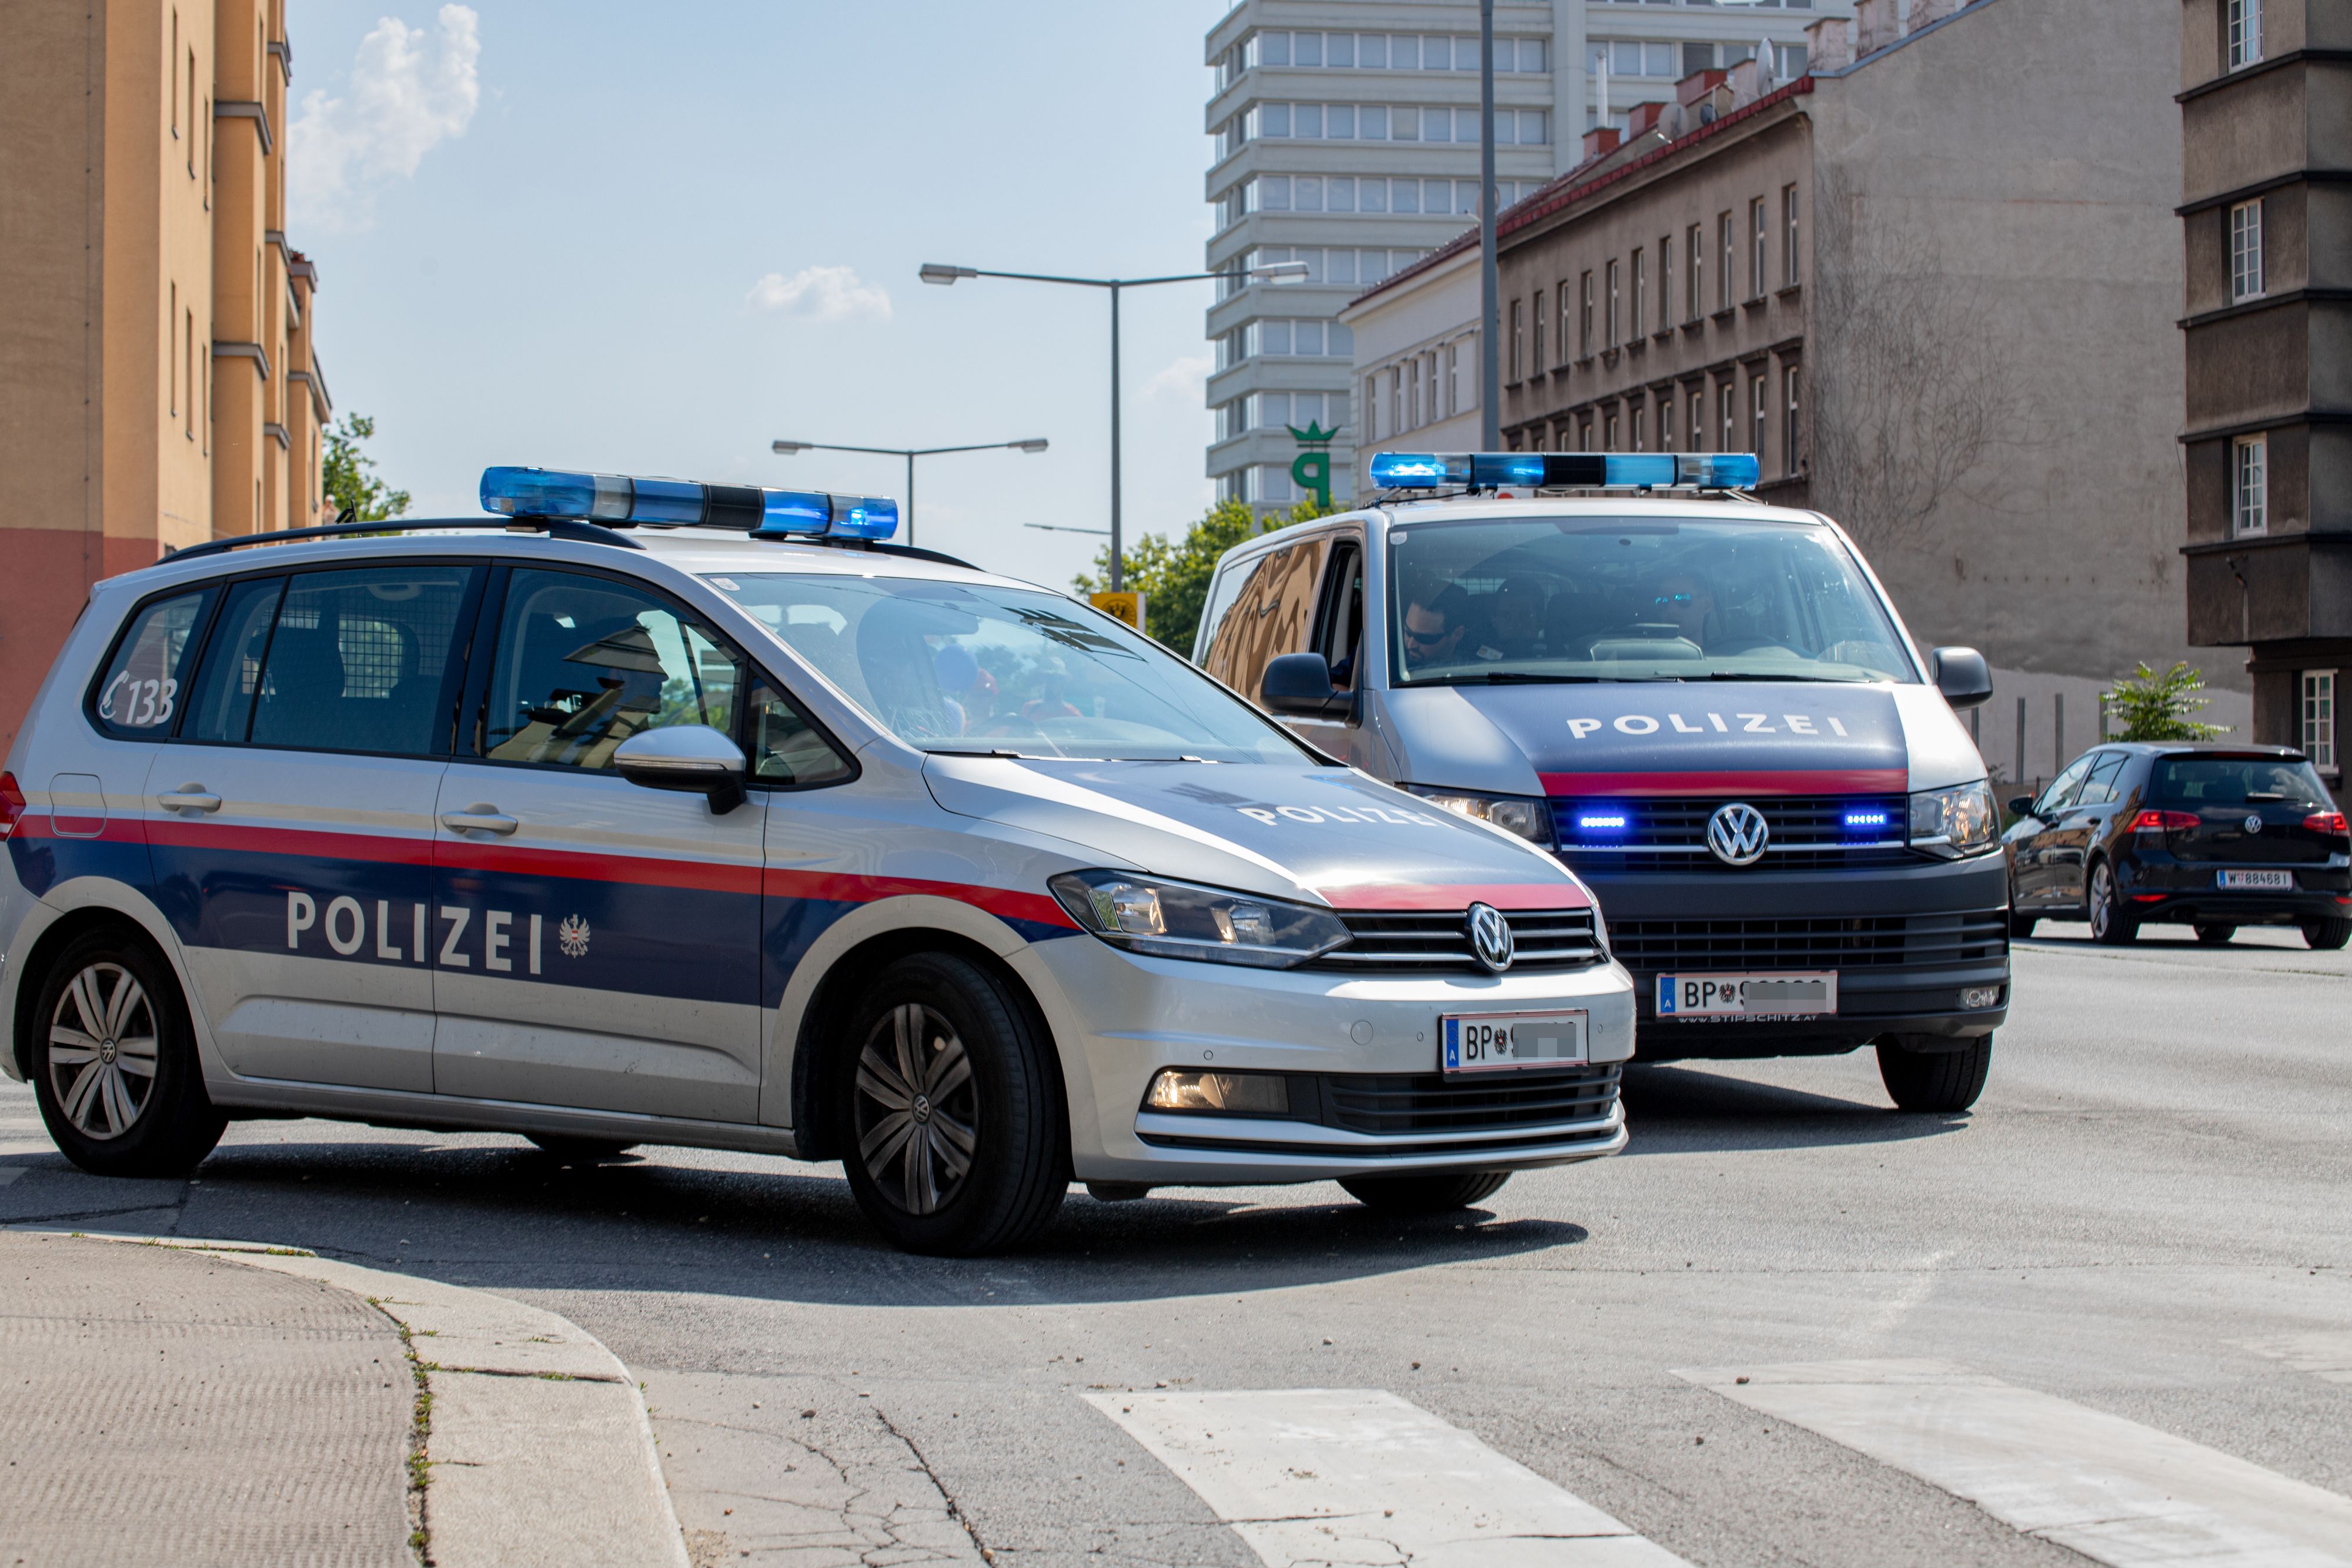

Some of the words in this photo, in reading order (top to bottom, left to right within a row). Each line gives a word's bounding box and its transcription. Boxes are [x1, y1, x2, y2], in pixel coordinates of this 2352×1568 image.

[126, 678, 178, 724] 133
[1566, 713, 1847, 739] POLIZEI
[1236, 806, 1457, 829] POLIZEI
[1708, 803, 1768, 865] VW
[287, 891, 542, 974] POLIZEI
[1472, 904, 1514, 971] VW
[1684, 981, 1716, 1008] BP
[1466, 1025, 1492, 1060] BP
